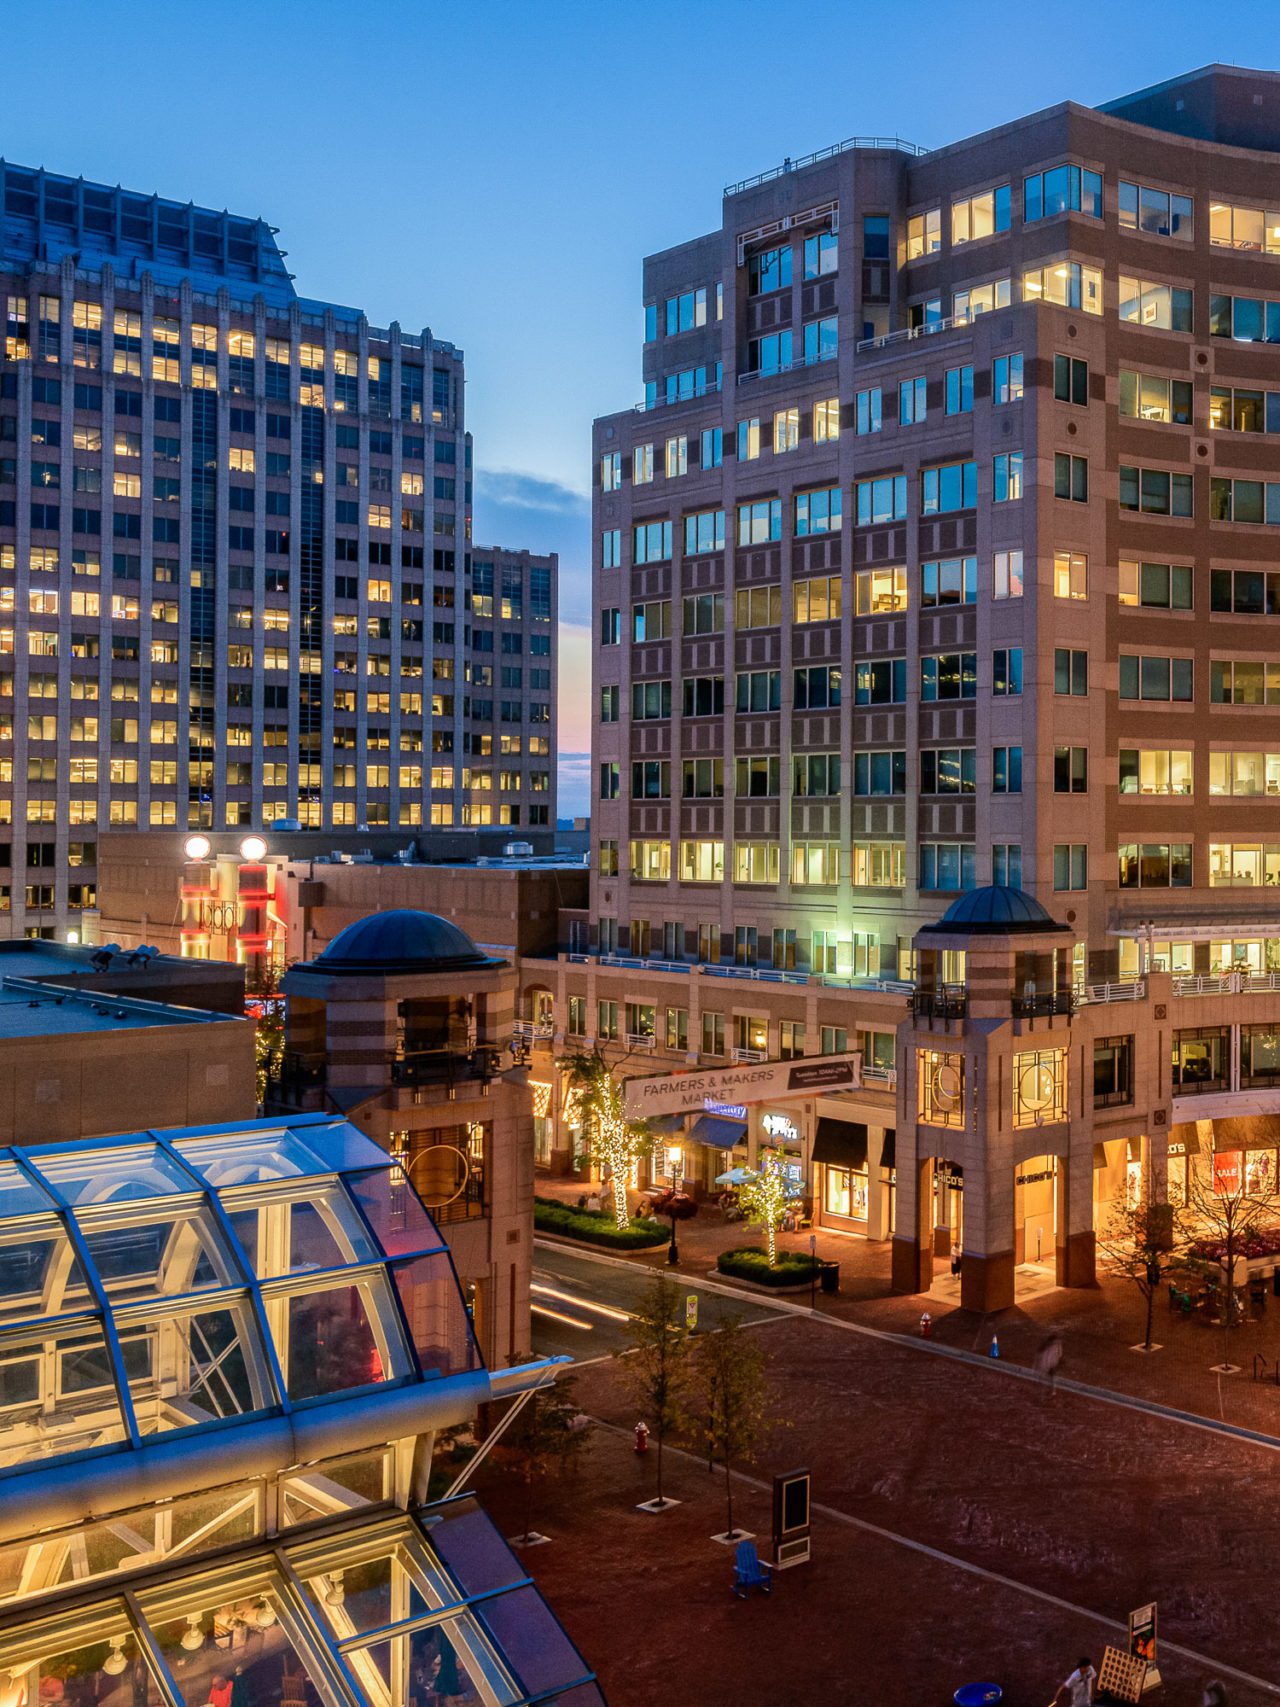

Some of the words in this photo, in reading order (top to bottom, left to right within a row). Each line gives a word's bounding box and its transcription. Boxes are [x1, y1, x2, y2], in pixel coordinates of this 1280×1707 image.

[643, 1079, 705, 1097] FARMERS
[708, 1076, 718, 1088] &
[721, 1069, 775, 1086] MAKERS
[681, 1088, 736, 1106] MARKET
[933, 1173, 964, 1187] CHICO'S
[1216, 1168, 1237, 1177] SALE
